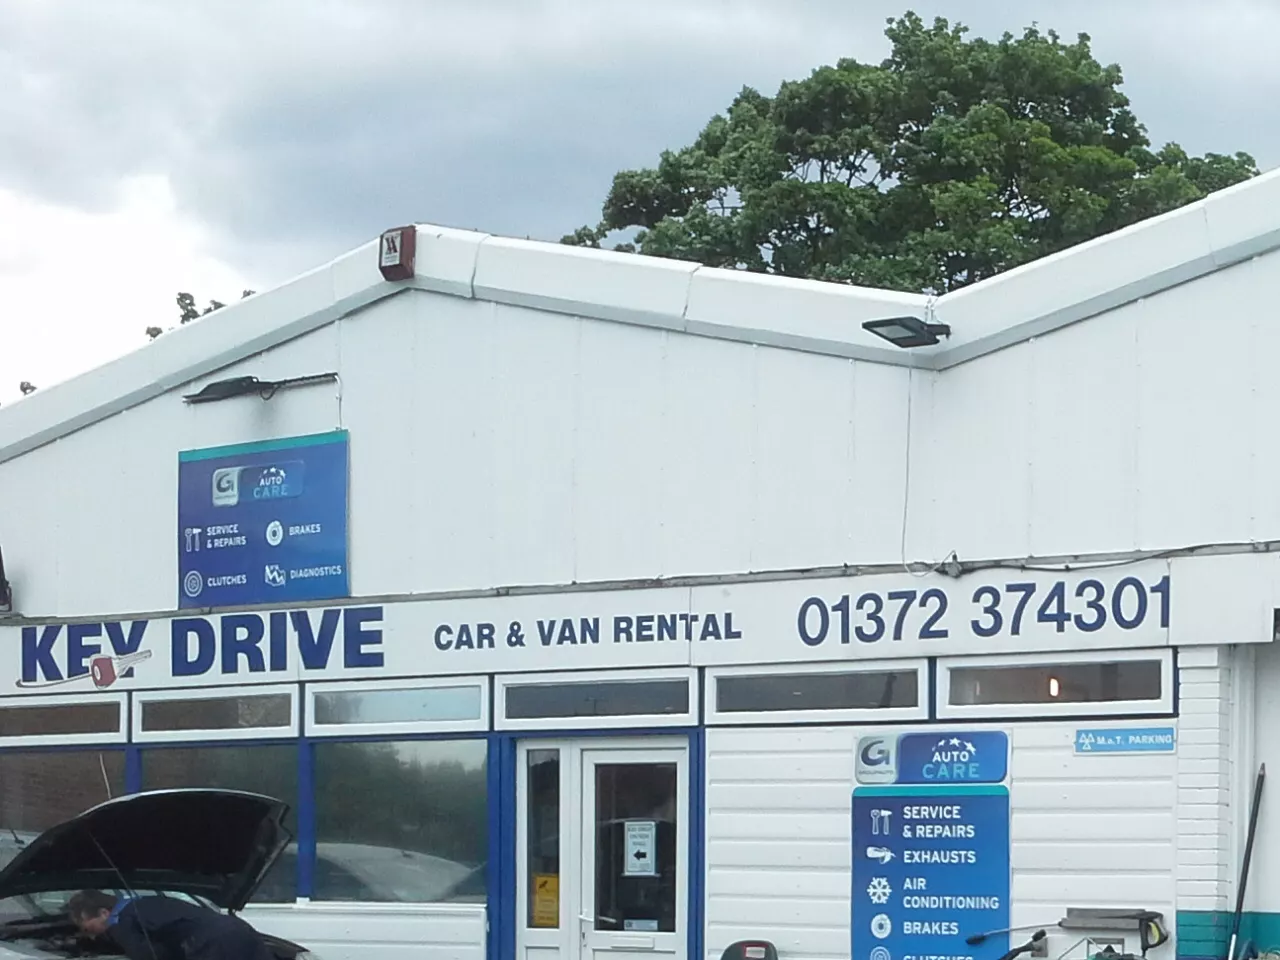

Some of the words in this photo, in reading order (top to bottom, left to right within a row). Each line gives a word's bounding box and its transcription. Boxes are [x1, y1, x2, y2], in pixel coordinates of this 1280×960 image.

[260, 477, 282, 487] AUTO
[253, 484, 288, 499] CARE
[206, 524, 239, 536] SERVICE
[289, 523, 321, 536] BRAKES
[206, 540, 212, 549] &
[214, 536, 247, 548] REPAIRS
[290, 565, 342, 579] DIAGNOSTICS
[207, 574, 247, 587] CLUTCHES
[797, 588, 949, 647] 01372
[971, 575, 1170, 638] 374301
[434, 623, 495, 651] CAR
[506, 621, 526, 648] &
[536, 617, 600, 646] VAN
[613, 612, 742, 643] RENTAL
[21, 620, 148, 682] KEY
[171, 606, 384, 677] DRIVE
[1129, 734, 1172, 745] PARKING
[932, 751, 969, 763] AUTO
[922, 763, 980, 779] CARE
[903, 806, 961, 819] SERVICE
[902, 825, 912, 838] &
[916, 825, 975, 838] REPAIRS
[903, 851, 976, 863] EXHAUSTS
[903, 878, 926, 890] AIR
[903, 896, 999, 909] CONDITIONING
[903, 922, 959, 934] BRAKES
